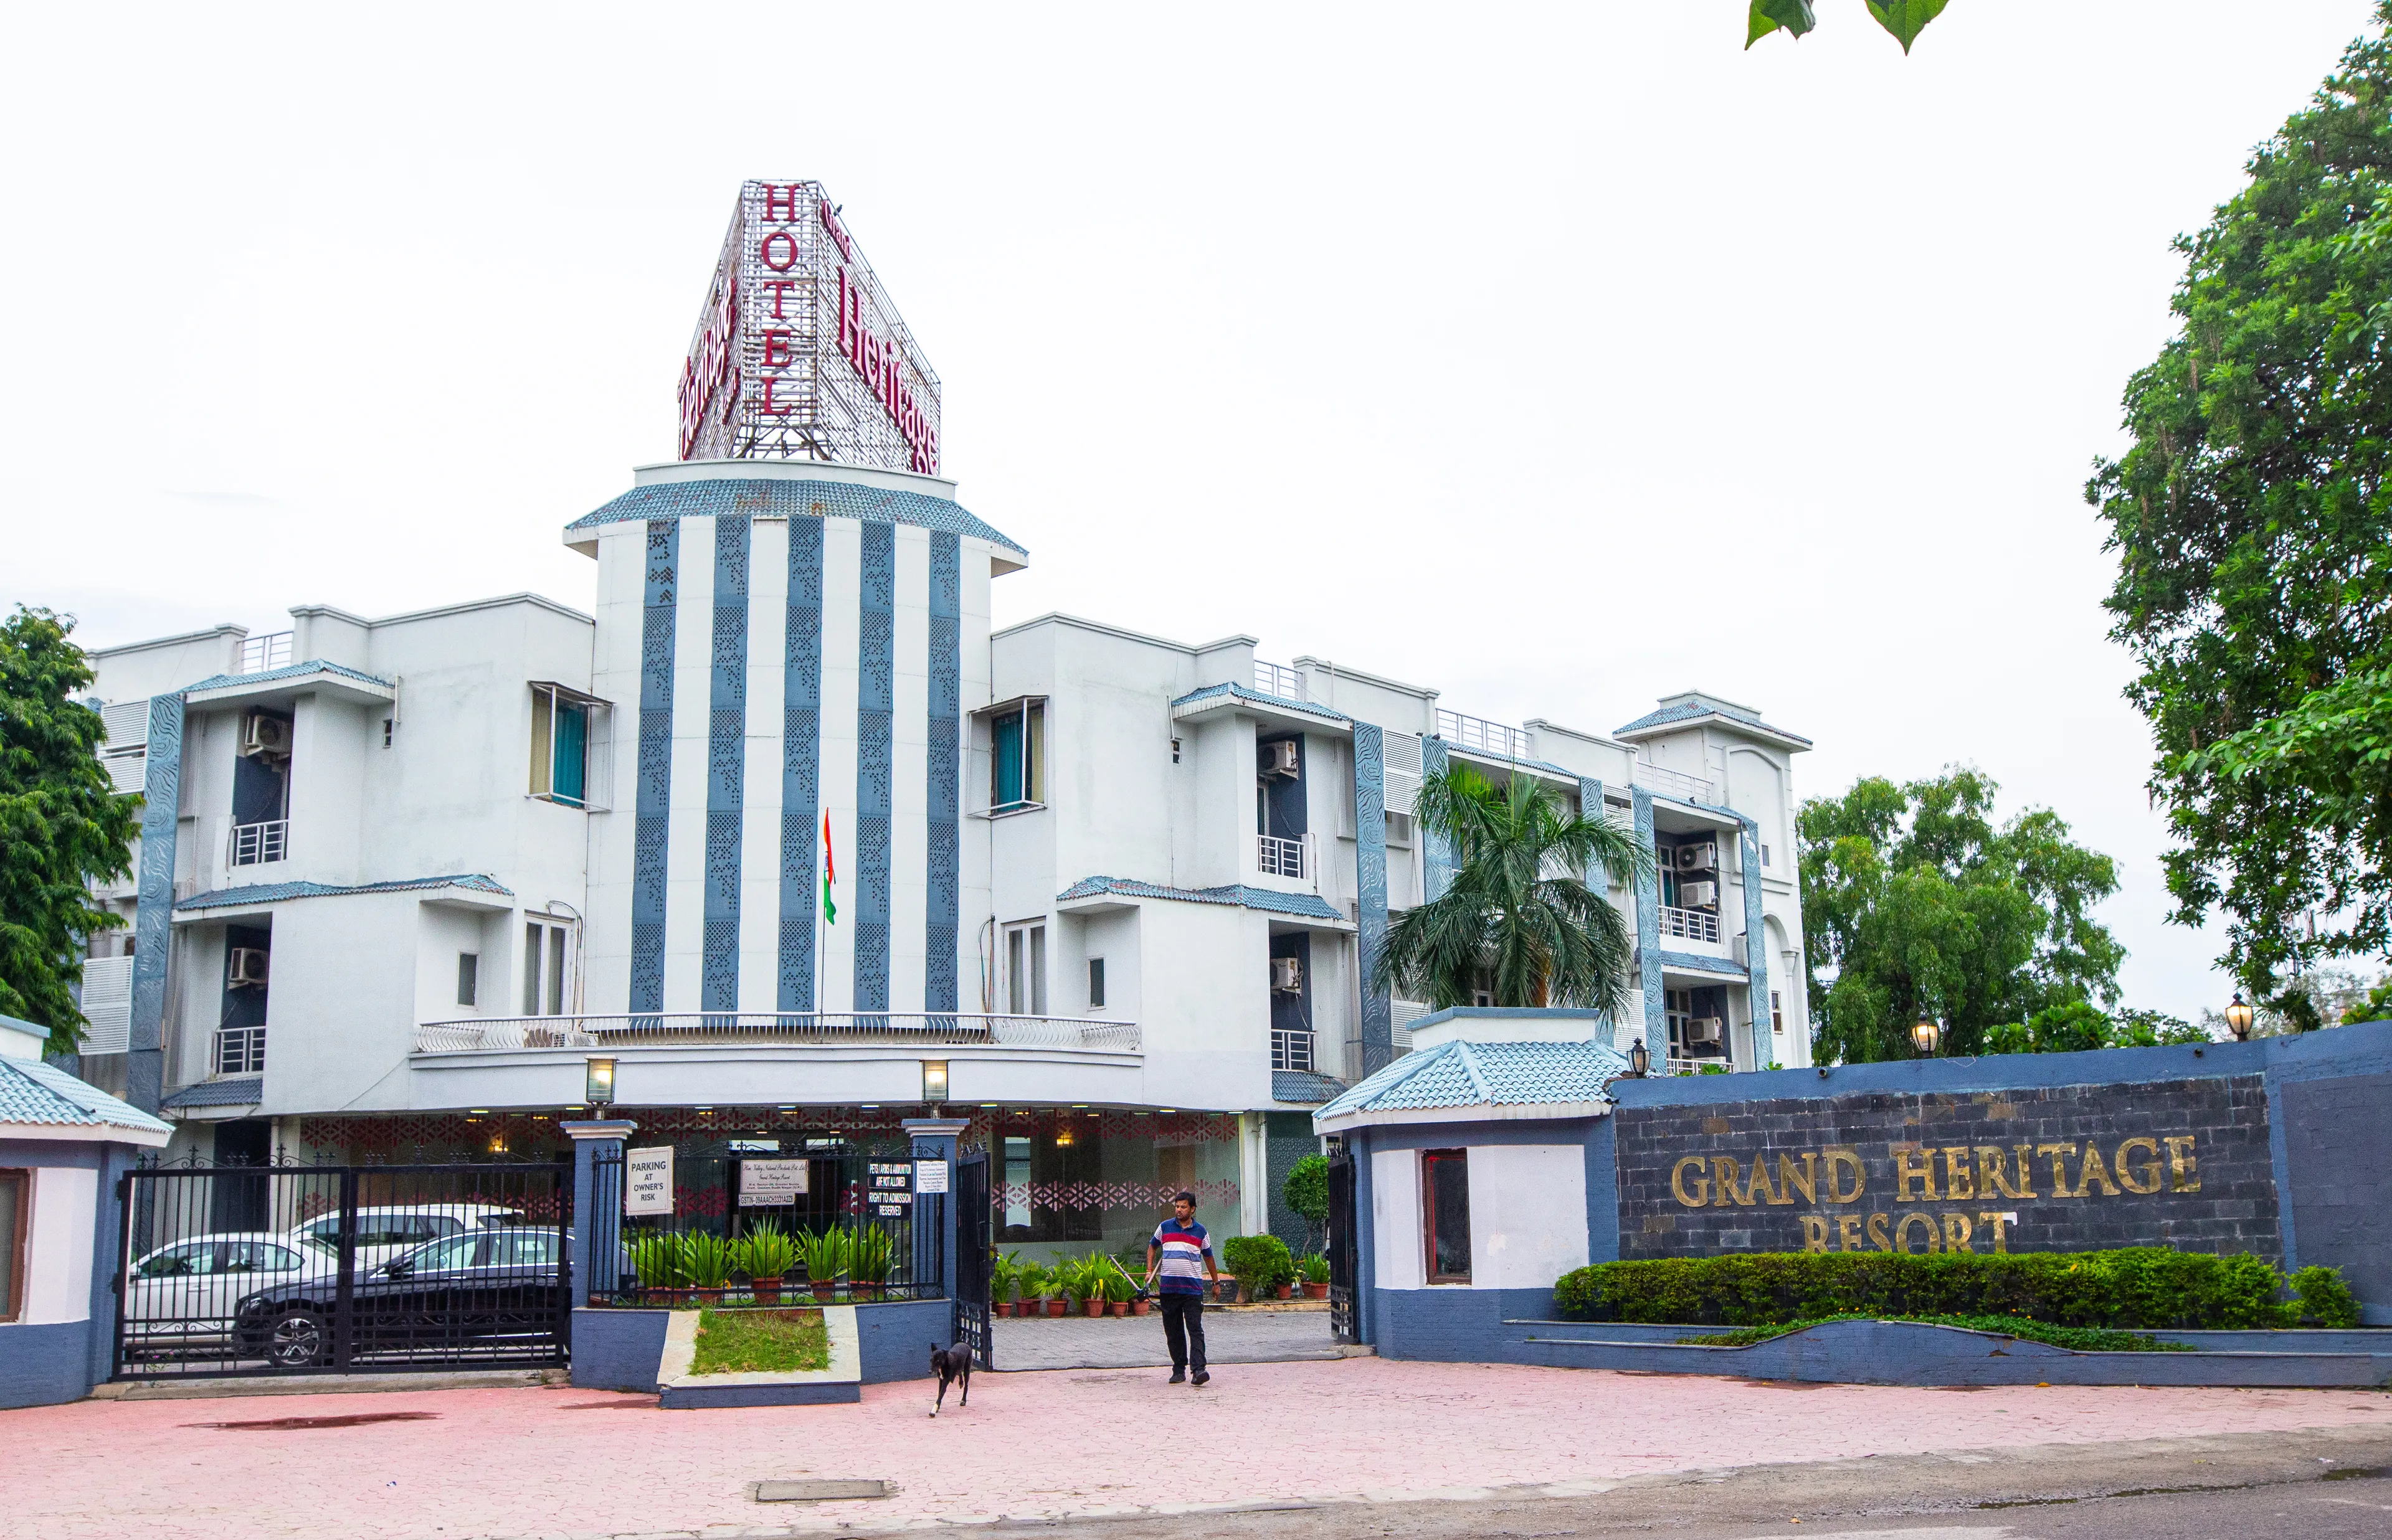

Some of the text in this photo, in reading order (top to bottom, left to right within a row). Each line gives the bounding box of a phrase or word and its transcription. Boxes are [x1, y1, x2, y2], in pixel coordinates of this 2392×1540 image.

[822, 200, 851, 263] Grand
[761, 184, 800, 415] HOTEL
[837, 266, 937, 475] Heritage
[631, 1161, 667, 1172] PARKING
[870, 1164, 878, 1174] PETS
[1671, 1135, 2202, 1208] GRAND HERITAGE
[644, 1173, 653, 1181] AT
[890, 1176, 906, 1186] ALLOWED
[634, 1183, 664, 1192] OWNER'S
[640, 1193, 656, 1202] RISK
[869, 1192, 911, 1203] RIGHT TO ADMISSION
[879, 1206, 901, 1216] RESERVED
[1798, 1212, 2018, 1255] RESORT
